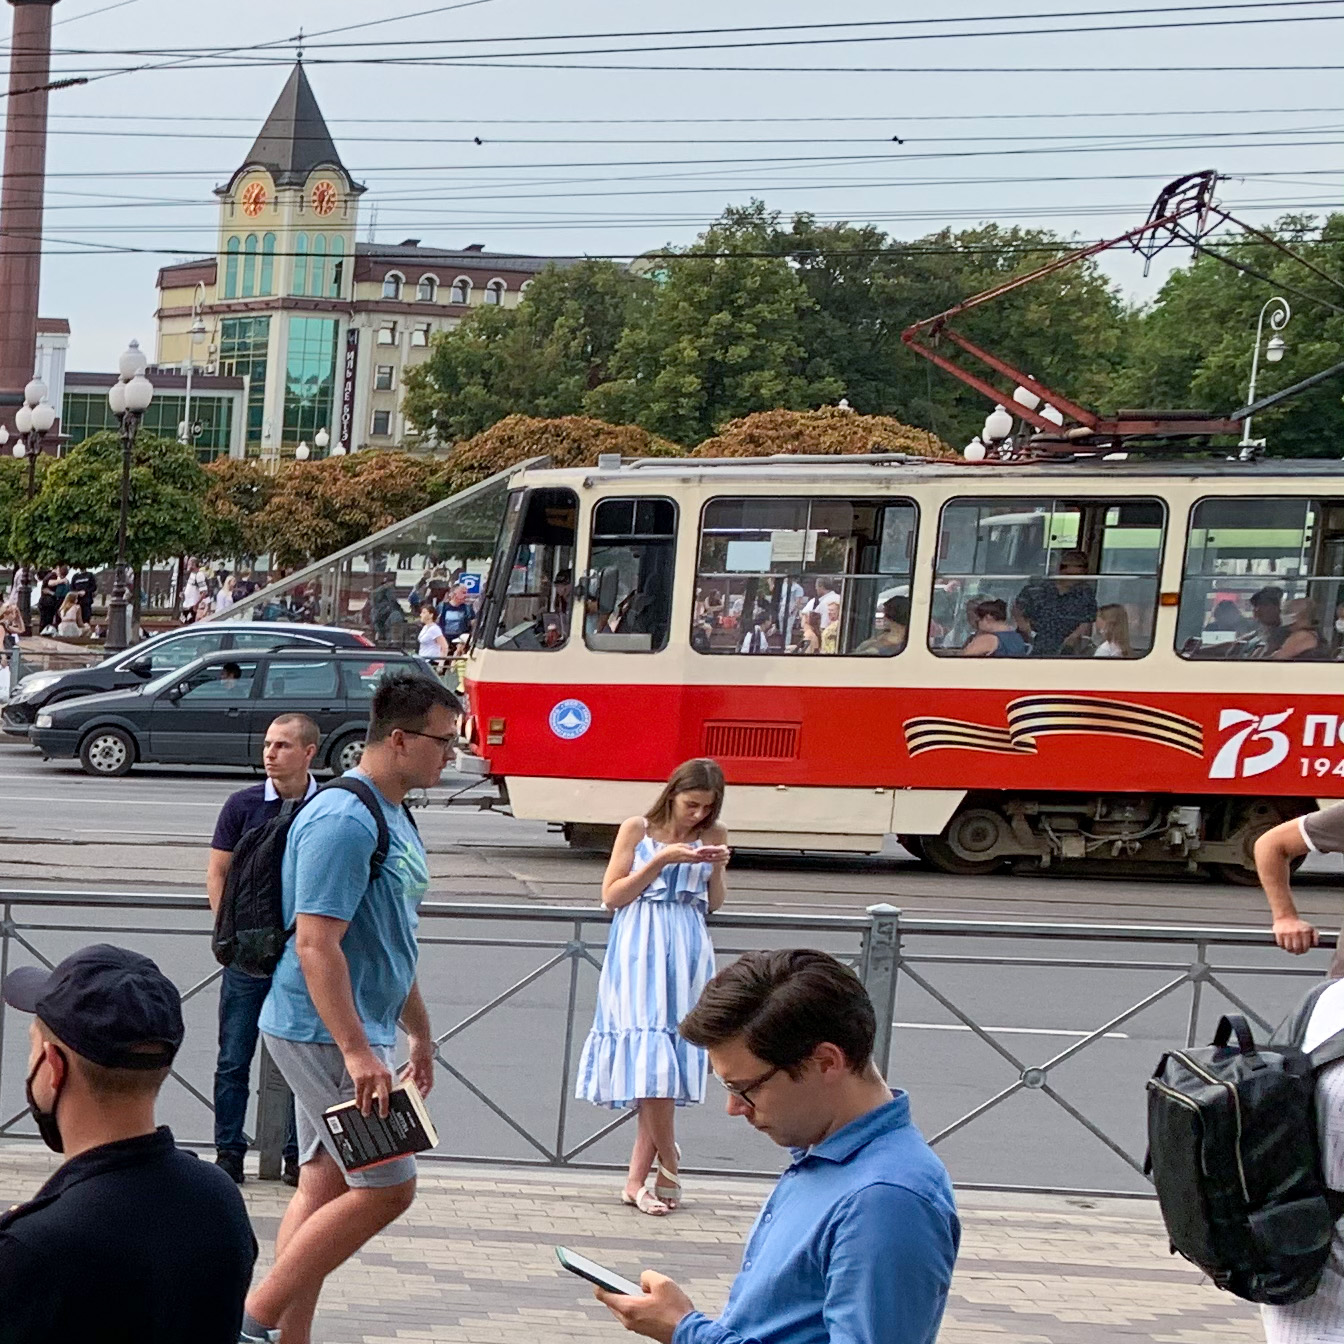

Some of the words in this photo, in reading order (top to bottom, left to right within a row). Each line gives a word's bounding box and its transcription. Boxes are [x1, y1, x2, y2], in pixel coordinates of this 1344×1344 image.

[346, 351, 354, 378] ИЛЬ
[344, 382, 352, 401] ДЕ
[1208, 707, 1295, 779] 75
[1302, 714, 1344, 747] П
